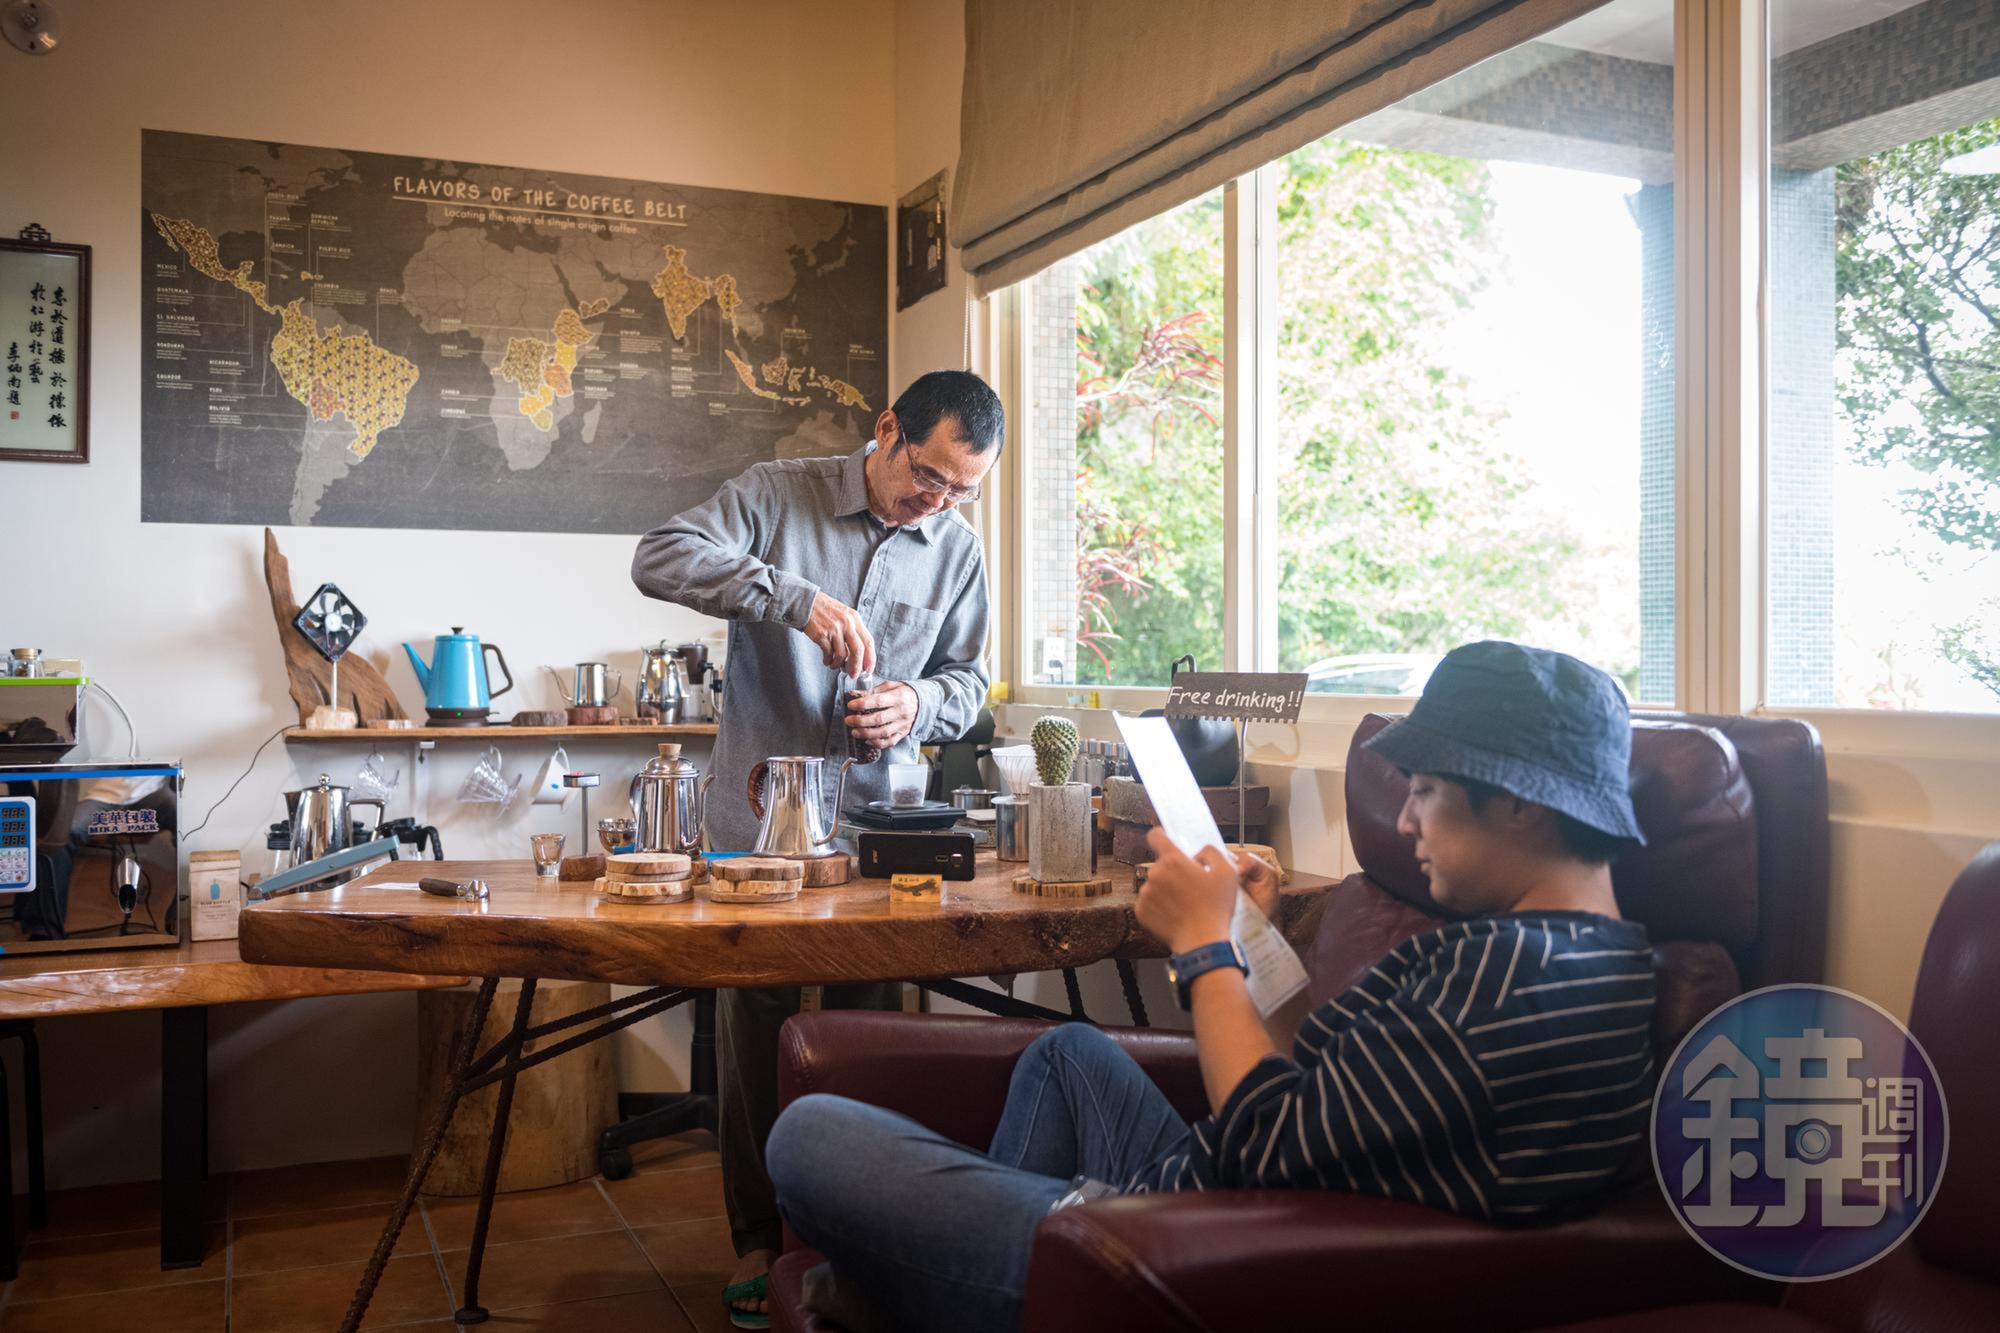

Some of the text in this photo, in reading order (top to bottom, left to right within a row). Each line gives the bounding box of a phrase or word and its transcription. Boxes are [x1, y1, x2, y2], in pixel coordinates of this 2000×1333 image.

[394, 176, 686, 219] FLAVORS OF THE COFFEE BELT
[444, 207, 637, 234] Locating the notes of single origin coffee
[1167, 686, 1302, 713] Free drinking!!
[89, 823, 157, 834] MIKA PACK
